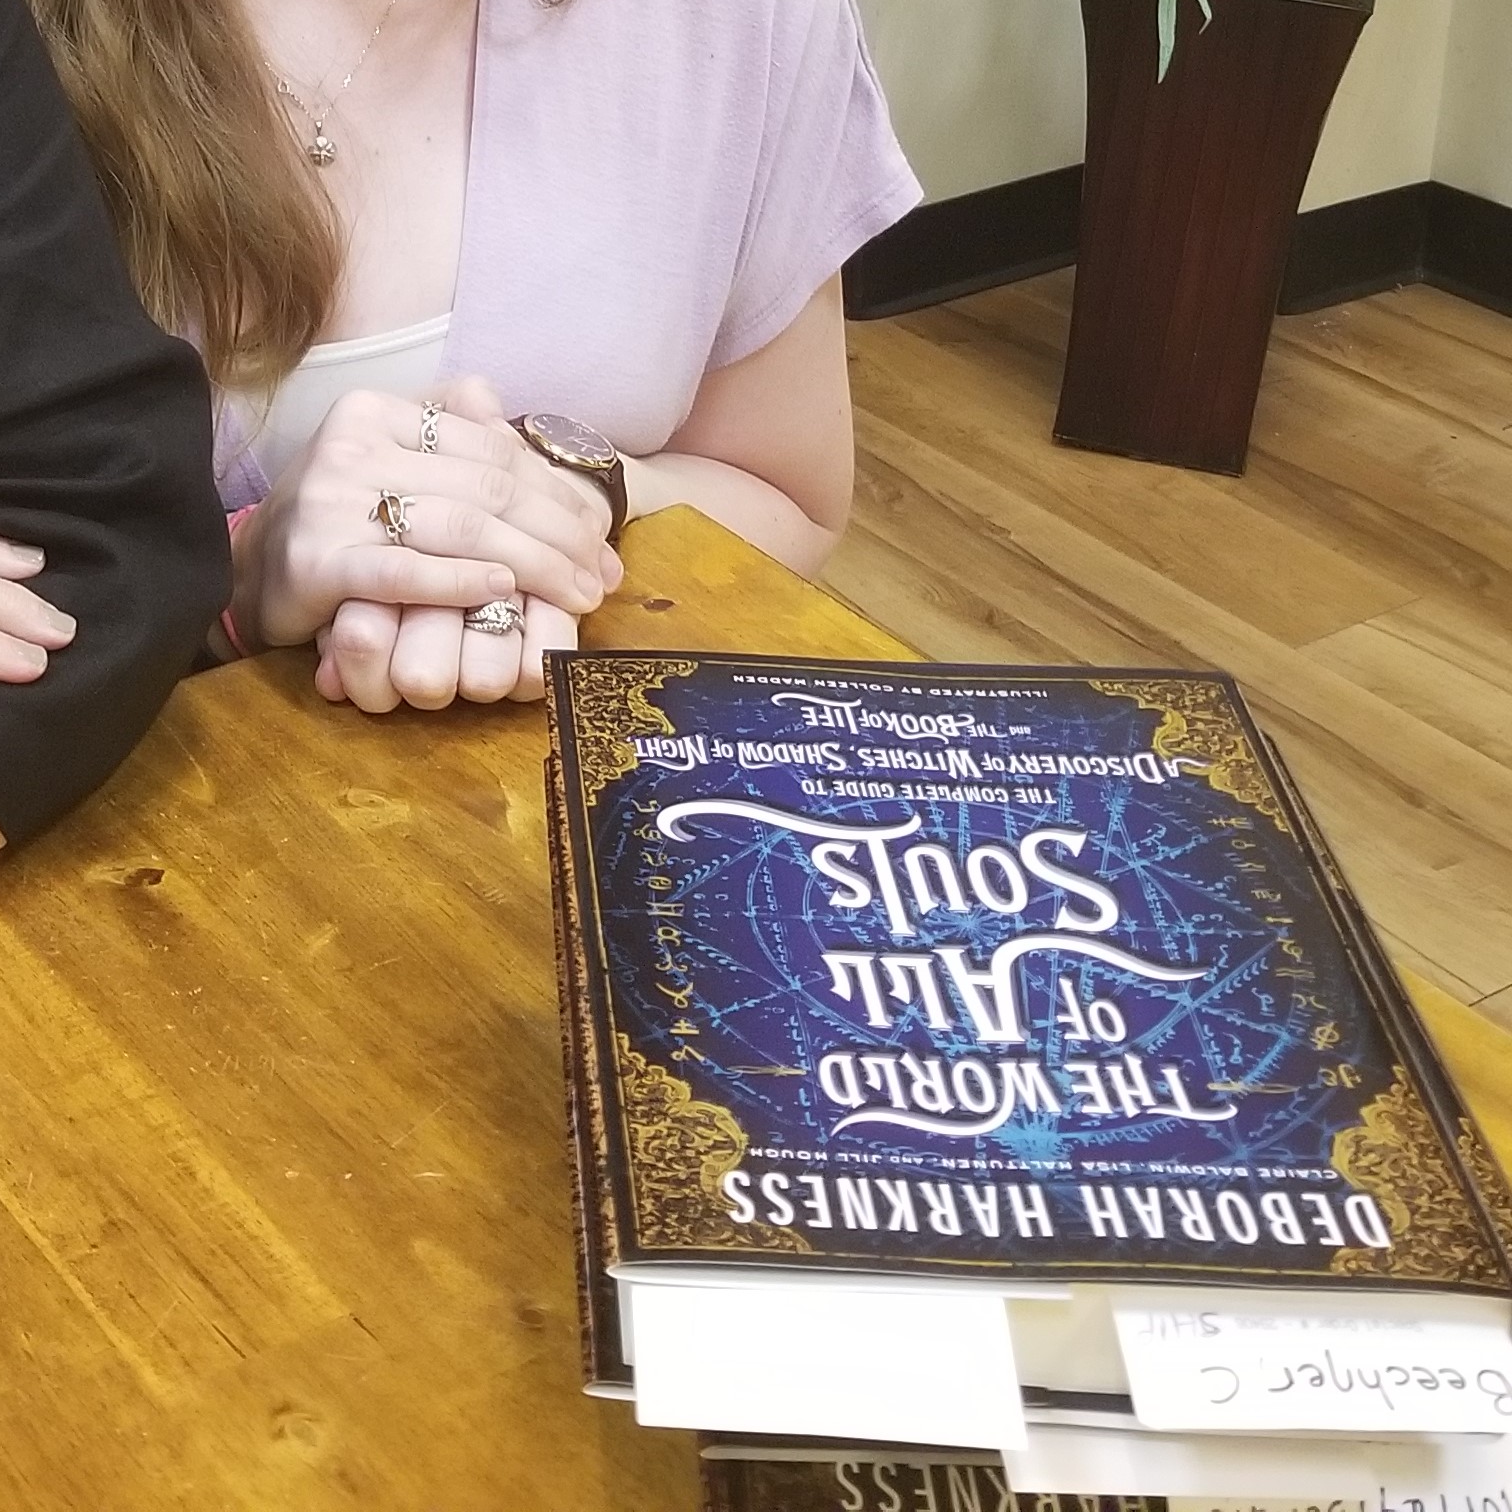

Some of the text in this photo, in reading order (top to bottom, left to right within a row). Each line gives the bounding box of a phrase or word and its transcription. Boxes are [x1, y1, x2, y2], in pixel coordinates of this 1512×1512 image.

[732, 674, 1048, 699] ILLUSTRATED BY COLLEEN MADDEN
[770, 692, 1032, 745] and THE BOOK OF LIFE
[708, 739, 734, 760] OF
[736, 739, 847, 772] SHADOW
[980, 751, 1006, 771] OF
[1008, 751, 1166, 785] DISCOVERY
[801, 779, 1056, 805] THE COMPLETE GUIDE TO
[655, 799, 1120, 937] SOULS
[1056, 976, 1127, 1042] OF
[818, 1049, 1238, 1137] THE WORLD
[748, 1146, 828, 1162] HOUGH
[837, 1152, 882, 1164] JILL
[889, 1155, 924, 1166] AND
[1081, 1161, 1131, 1173] LISA
[1257, 1167, 1338, 1180] CLAIRE
[722, 1169, 1392, 1249] DEBORAH HARKNESS
[1199, 1365, 1240, 1405] C
